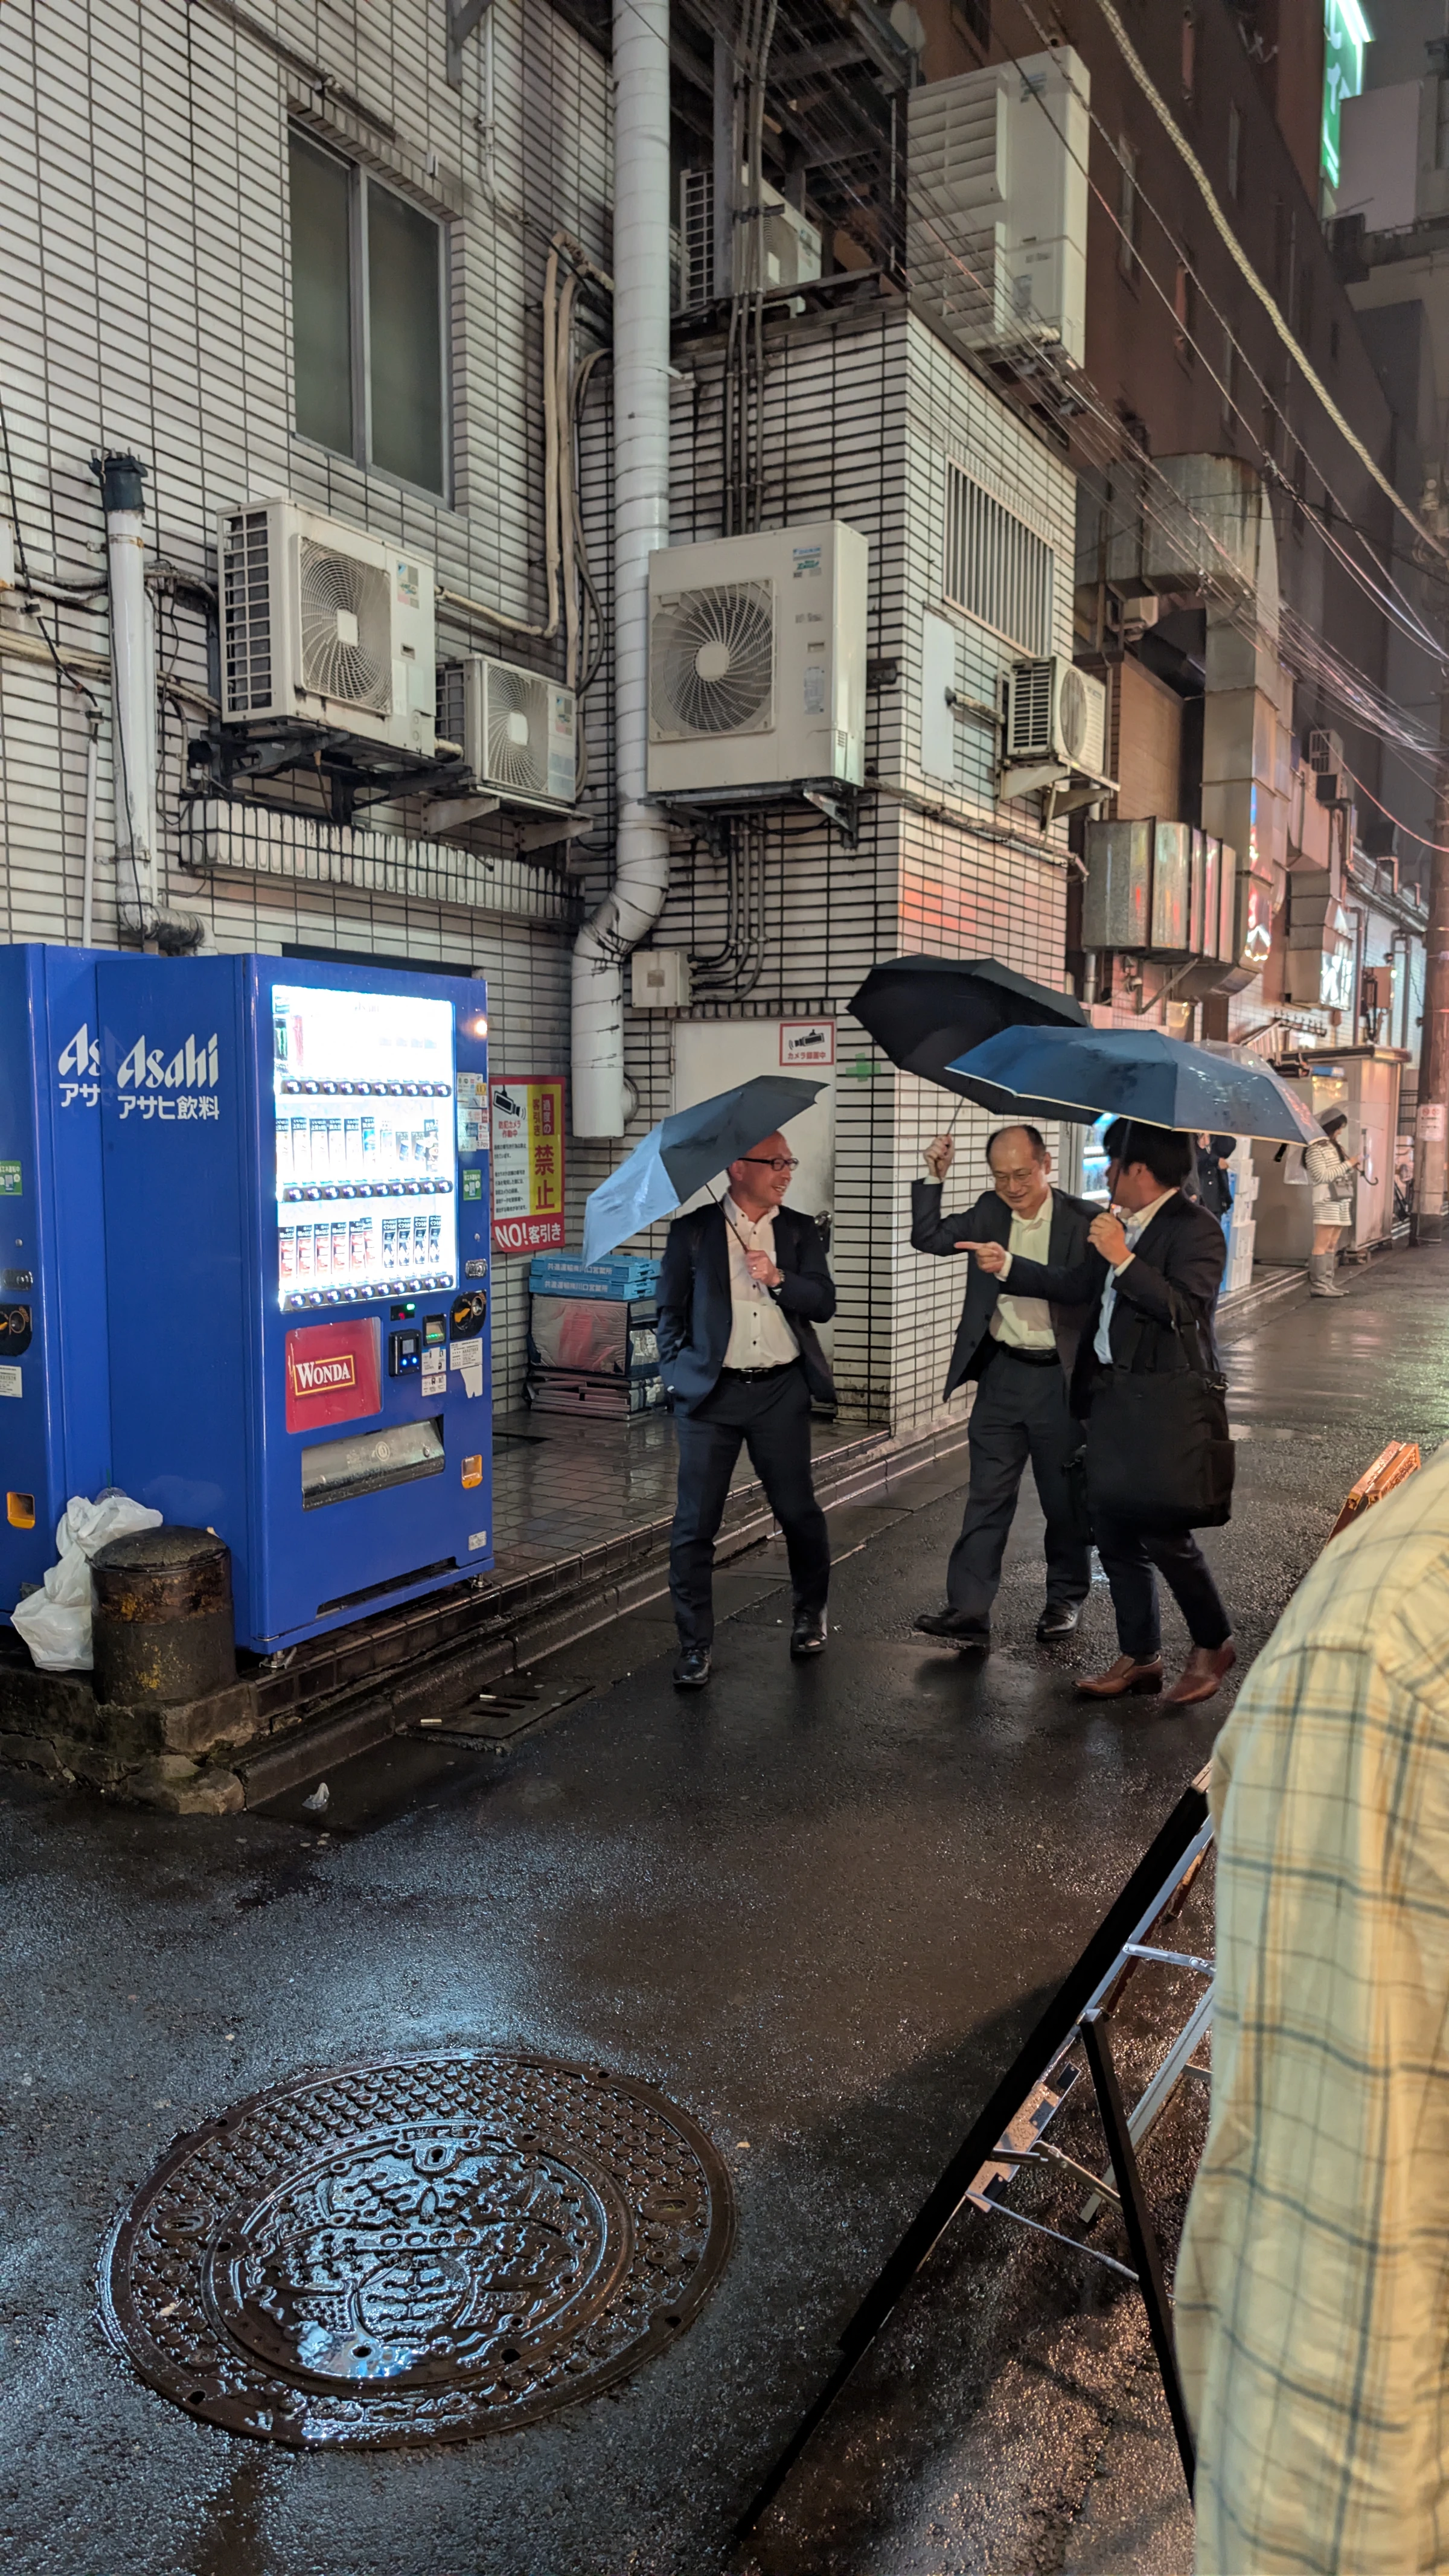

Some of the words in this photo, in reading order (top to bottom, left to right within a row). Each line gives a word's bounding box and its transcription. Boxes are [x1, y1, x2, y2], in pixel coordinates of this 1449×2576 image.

[117, 1033, 219, 1088] Asahi
[118, 1095, 220, 1120] アサヒ飲料
[533, 1099, 541, 1136] 客引き
[543, 1099, 552, 1134] 過度の
[499, 1120, 520, 1130] 防犯カメラ
[502, 1130, 517, 1138] 作動中
[534, 1144, 555, 1210] 禁止
[296, 1362, 351, 1389] WONDA
